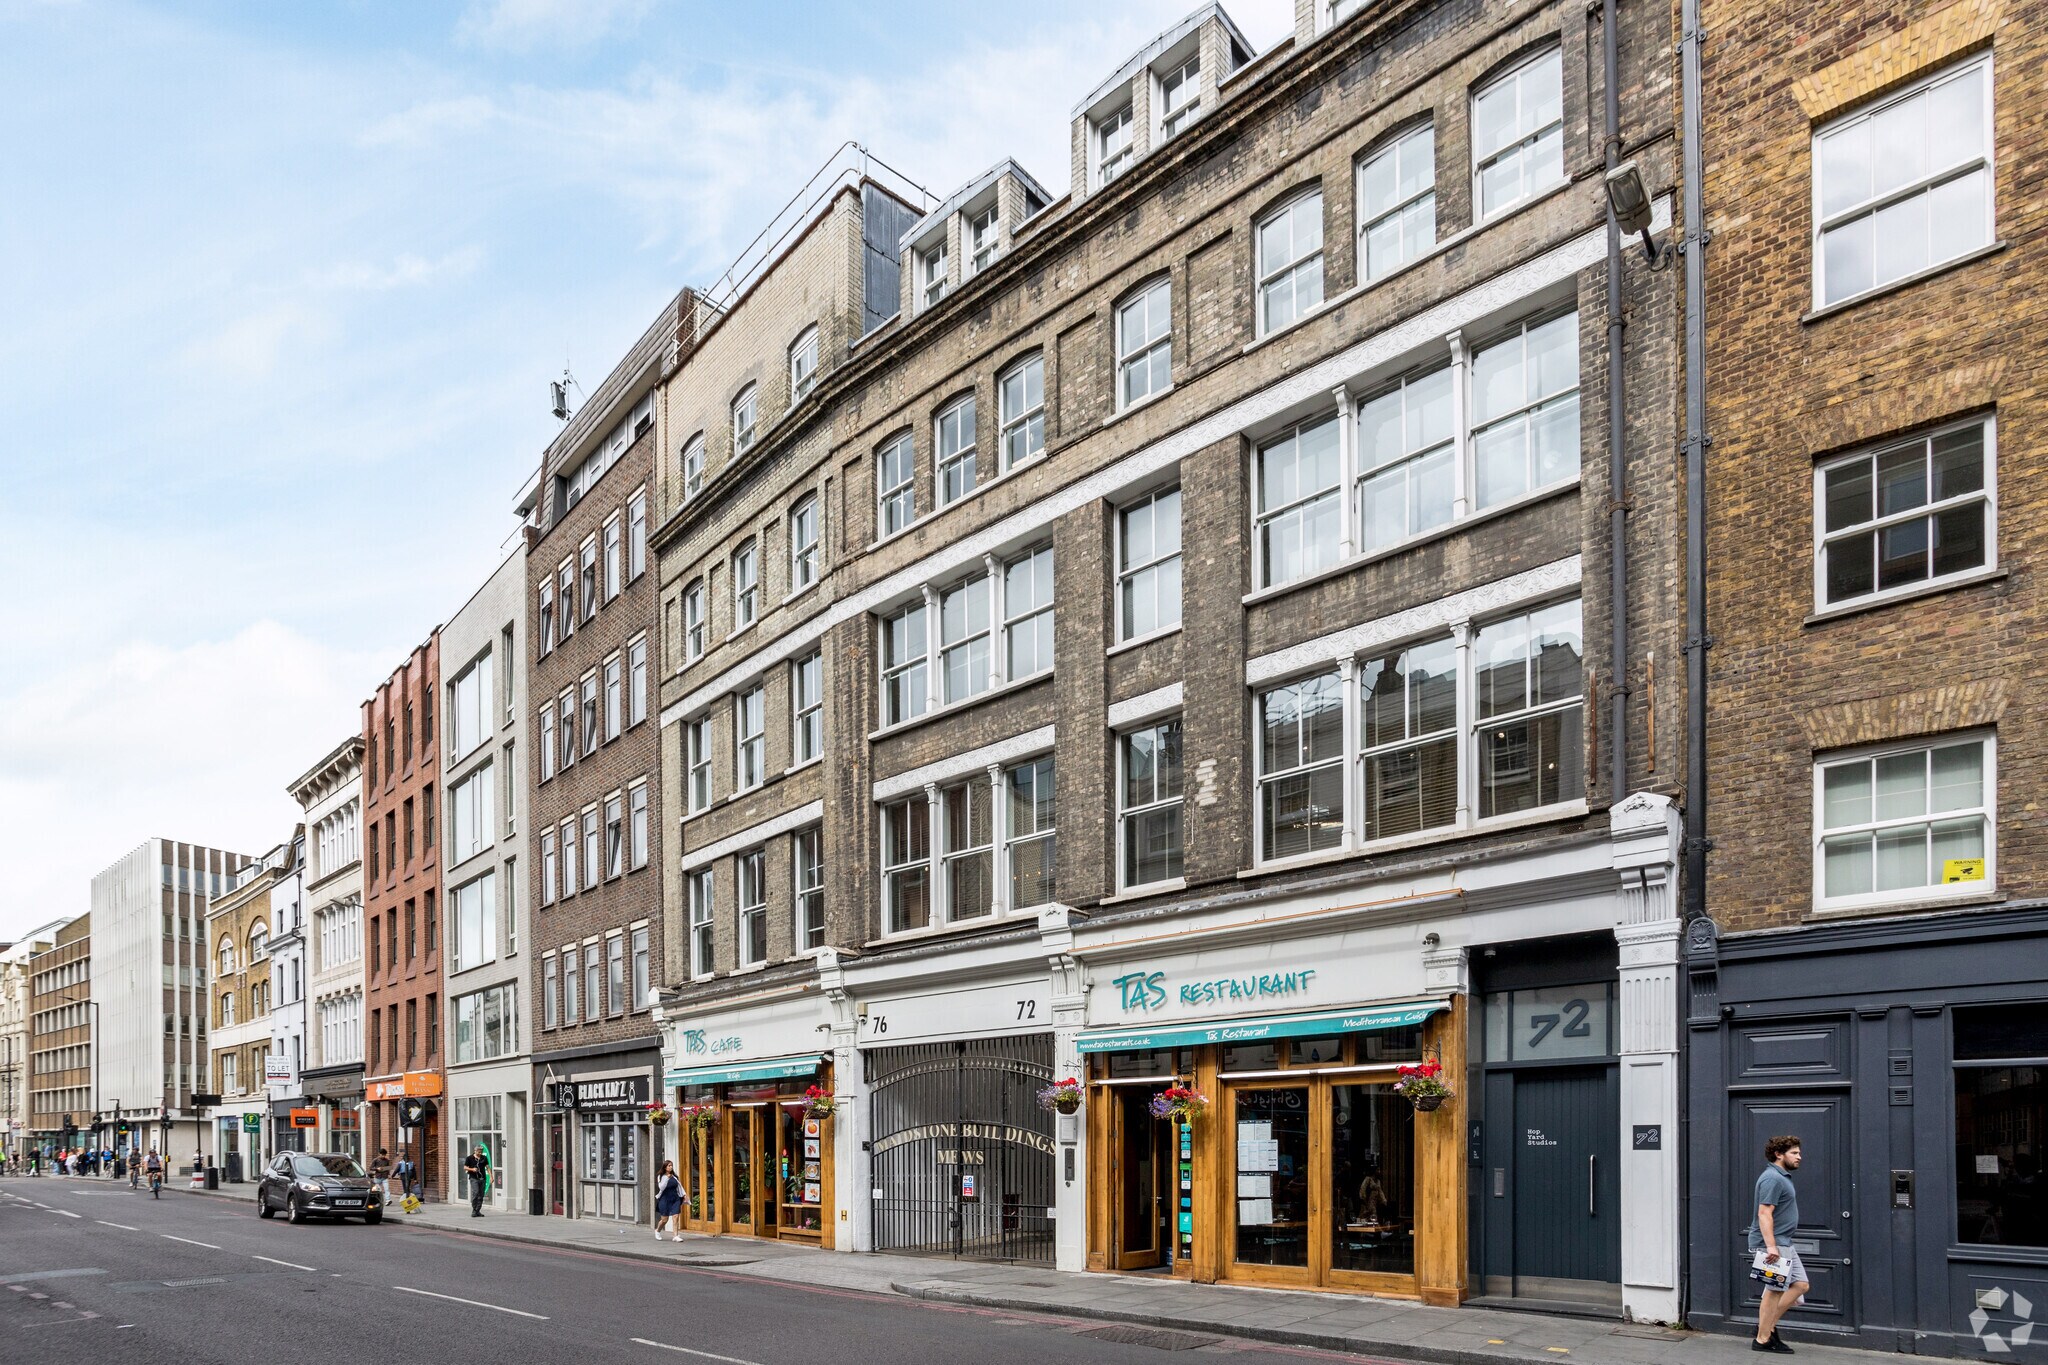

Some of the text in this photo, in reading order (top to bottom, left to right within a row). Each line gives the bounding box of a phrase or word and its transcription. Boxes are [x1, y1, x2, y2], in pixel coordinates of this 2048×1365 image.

[1112, 970, 1316, 1010] TAS RESTAURANT
[1016, 999, 1036, 1021] 72
[873, 1015, 888, 1035] 76
[1342, 1016, 1402, 1028] Mediterranean
[1529, 998, 1591, 1048] 72
[683, 1029, 743, 1054] TAS CAFE
[1206, 1026, 1270, 1041] Tas Restaurant
[578, 1083, 605, 1100] BLACK
[877, 1124, 1056, 1155] MAIDSTONE BUILDINGS
[1635, 1128, 1659, 1145] 72
[937, 1150, 985, 1165] MEWS
